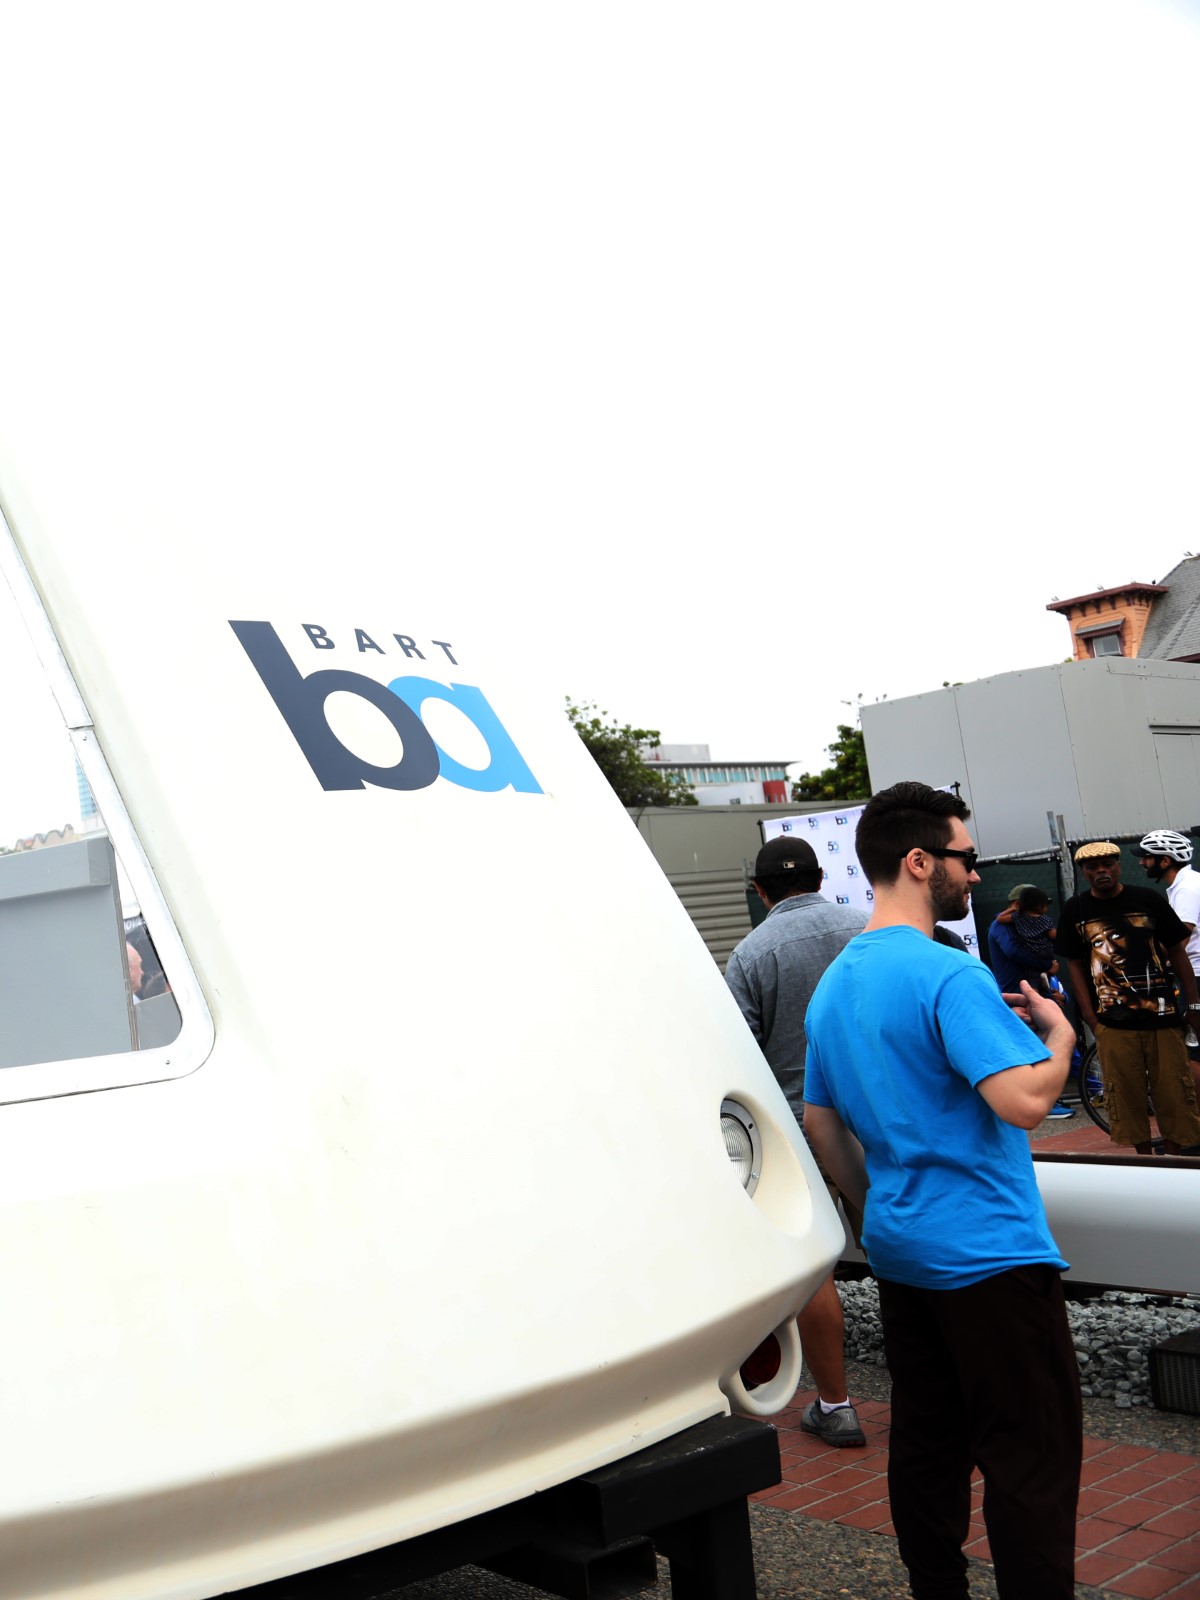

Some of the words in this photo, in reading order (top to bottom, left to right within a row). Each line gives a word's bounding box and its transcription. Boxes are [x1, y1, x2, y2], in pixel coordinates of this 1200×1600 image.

[301, 623, 458, 665] BART
[827, 841, 839, 852] 50
[846, 865, 858, 876] 50
[963, 934, 978, 946] 50
